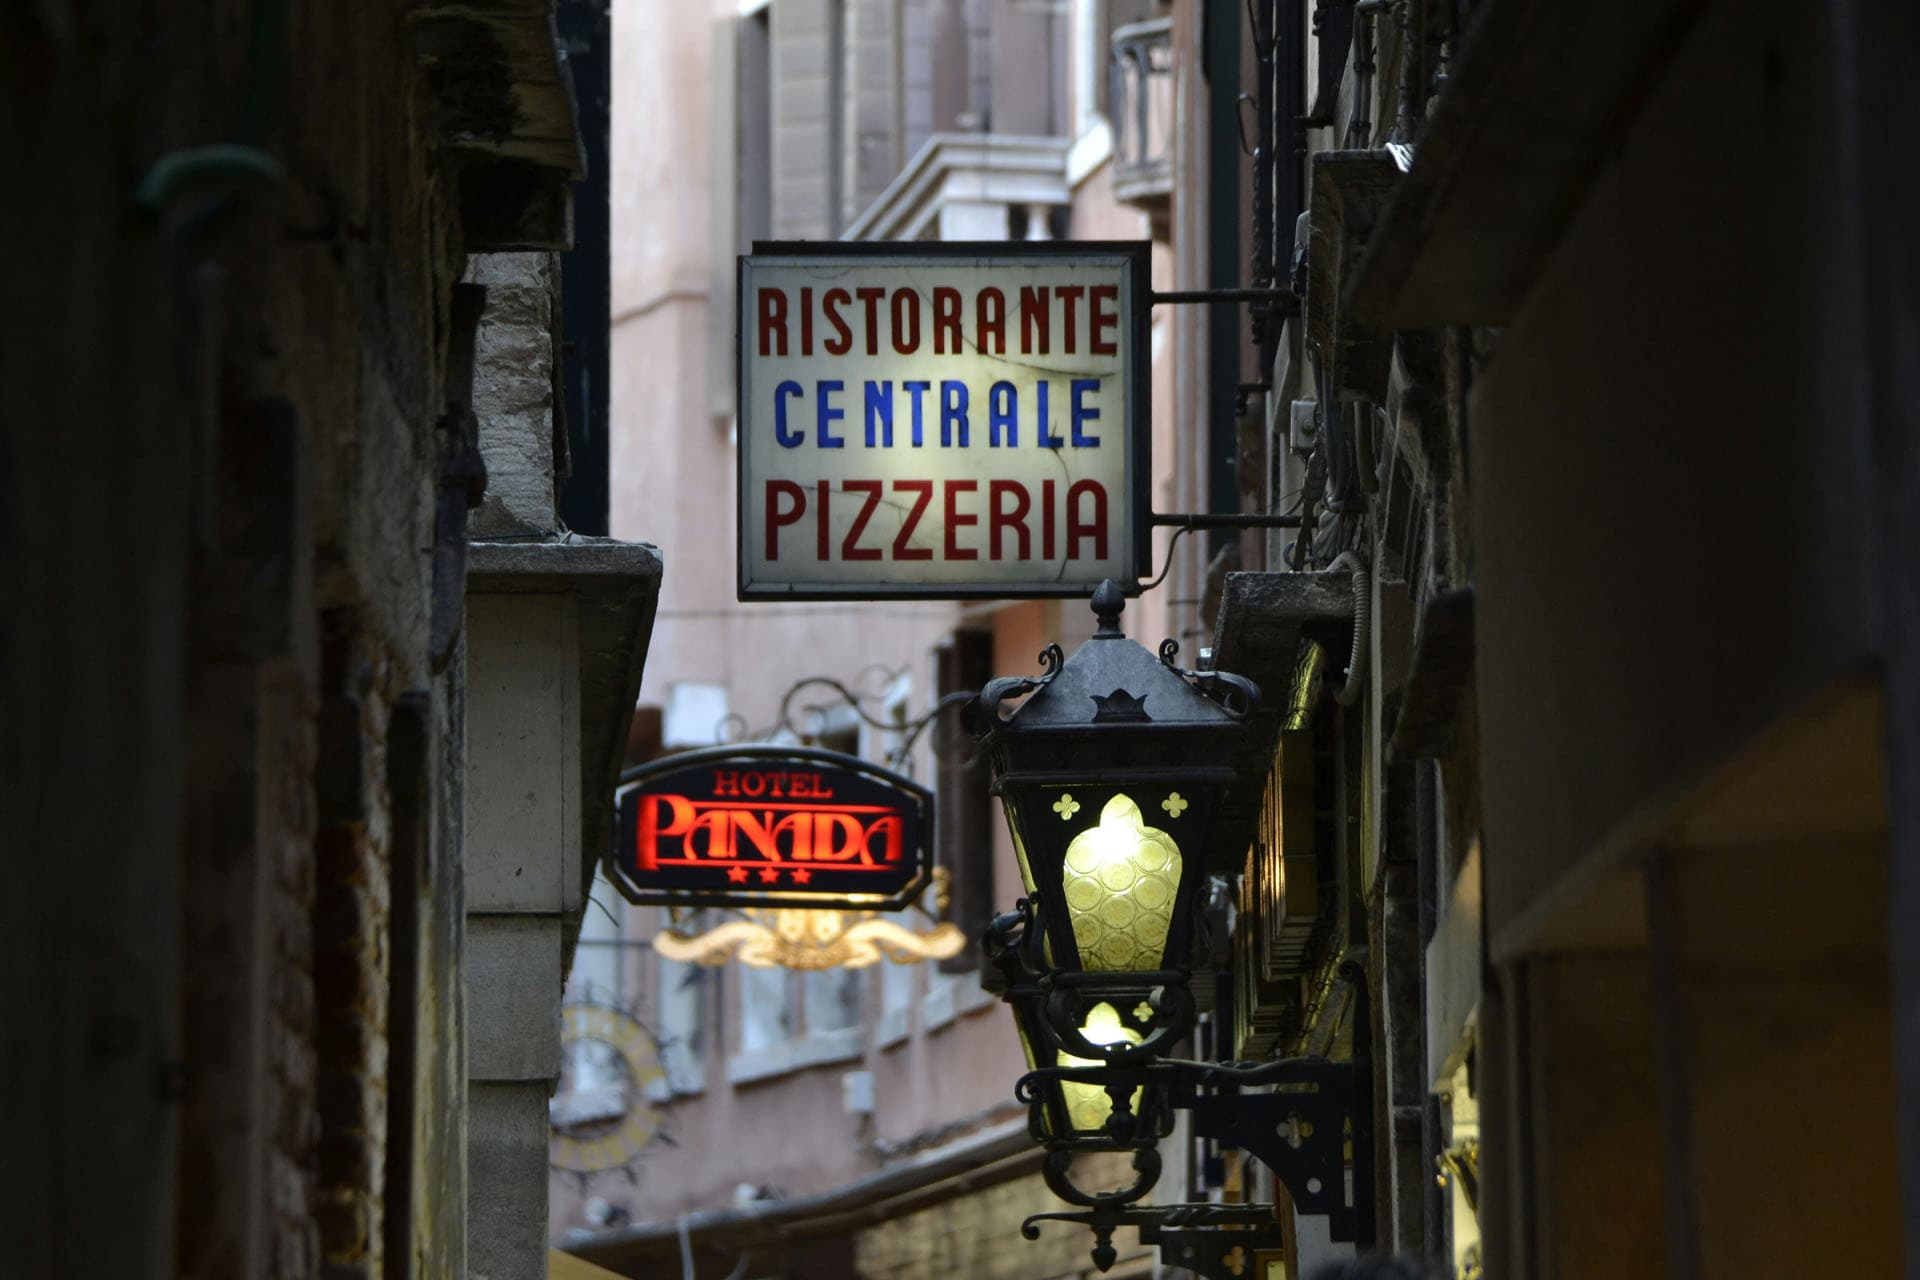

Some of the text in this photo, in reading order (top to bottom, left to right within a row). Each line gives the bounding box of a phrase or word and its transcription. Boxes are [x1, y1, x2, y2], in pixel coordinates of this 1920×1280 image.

[758, 285, 1118, 357] RISTORANTE
[774, 379, 1101, 449] CENTRALE
[765, 478, 1109, 561] PIZZERIA
[713, 770, 833, 799] HOTEL
[636, 794, 904, 871] PANADA
